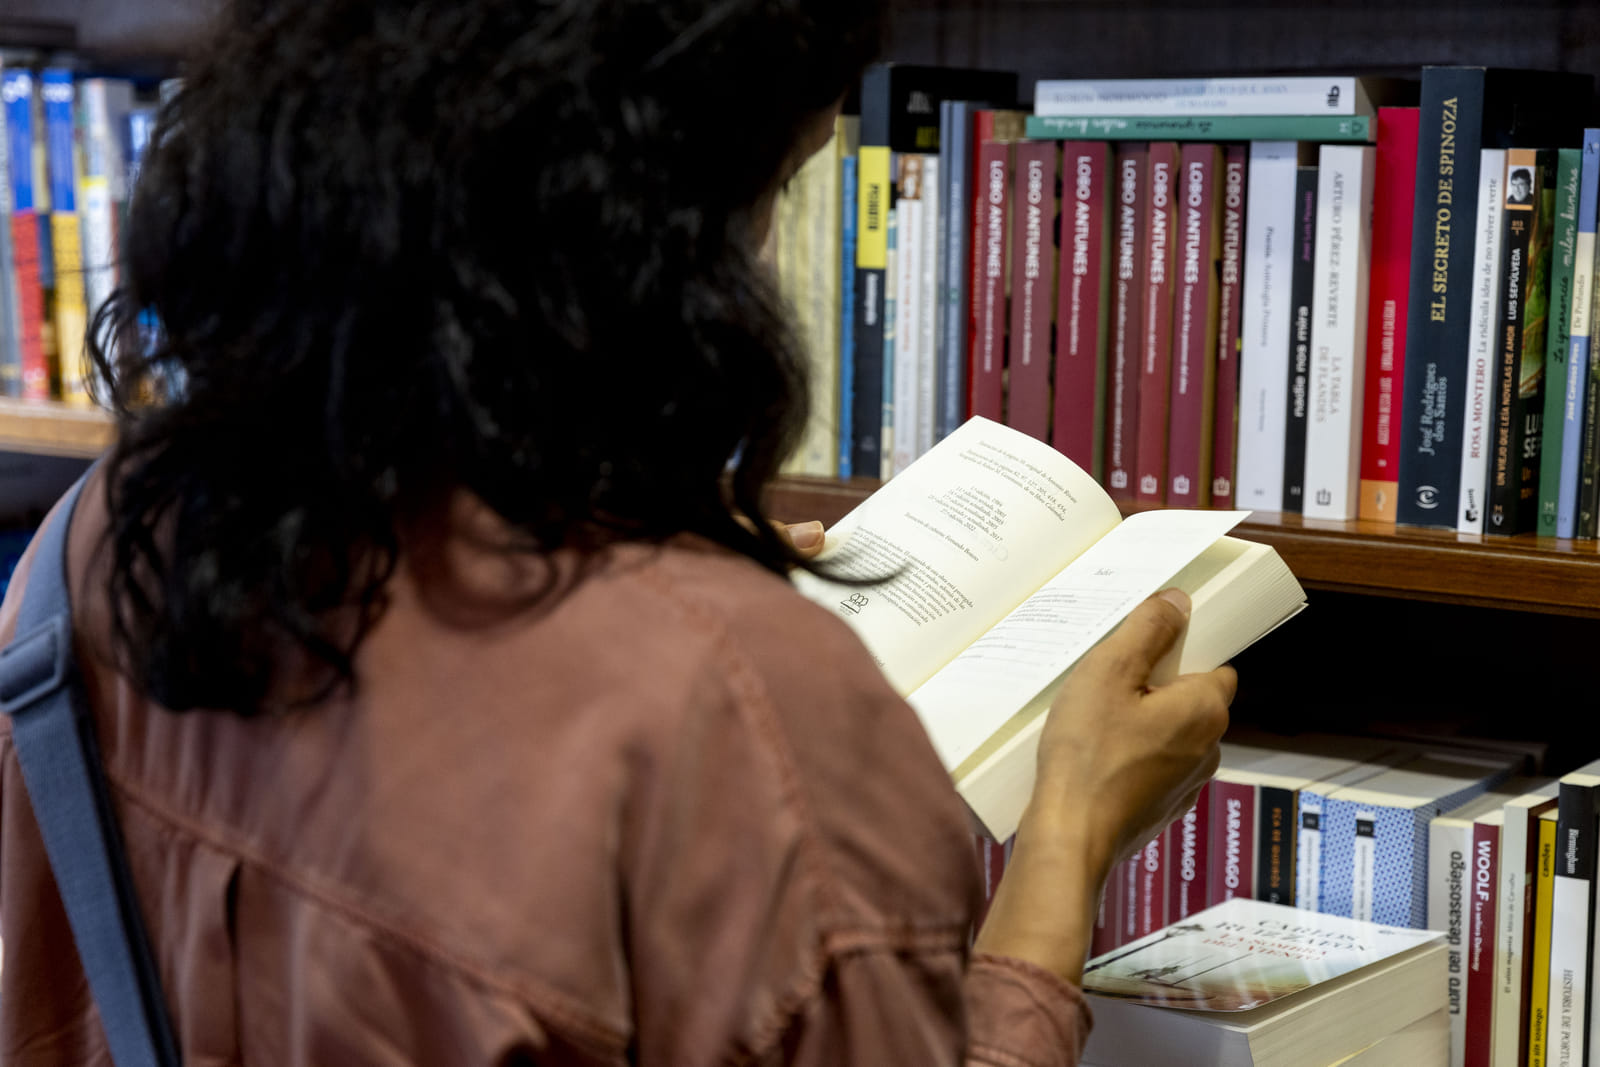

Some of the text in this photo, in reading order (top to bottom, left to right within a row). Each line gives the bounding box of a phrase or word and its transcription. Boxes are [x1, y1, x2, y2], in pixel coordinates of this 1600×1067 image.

[989, 160, 1003, 204] LOBO
[1077, 156, 1092, 200] LOBO
[1153, 162, 1168, 208] LOBO
[1188, 162, 1203, 208] LOBO
[1226, 163, 1241, 208] LOBO
[1331, 171, 1345, 223] ARTURO
[1487, 178, 1498, 202] verte
[1025, 160, 1042, 278] LOBO ANTUNES
[1119, 160, 1136, 280] LOBO ANTUNES
[1431, 97, 1458, 322] EL SECRETO DE SPINOZA
[1484, 214, 1496, 244] volver
[987, 205, 1002, 278] ANTUNES
[1073, 201, 1089, 275] ANTUNES
[1150, 208, 1166, 284] ANTUNES
[1184, 208, 1200, 284] ANTUNES
[1222, 208, 1238, 284] ANTUNES
[1485, 247, 1492, 261] no
[1480, 277, 1490, 297] idea
[1481, 263, 1491, 275] de
[1508, 247, 1521, 298] SEPÚLVEDA
[1477, 300, 1490, 338] ridícula
[1507, 301, 1518, 320] LUIS
[1476, 341, 1487, 353] La
[1504, 352, 1514, 364] DE
[1505, 325, 1516, 351] AMOR
[1292, 306, 1309, 417] nadie nos mira
[1567, 343, 1580, 421] José Cardoso Pires
[1473, 358, 1486, 423] MONTERO
[1503, 365, 1514, 405] NOVELAS
[1431, 376, 1447, 442] dos Santos
[1418, 427, 1435, 456] José
[1471, 427, 1481, 458] ROSA
[1499, 427, 1510, 446] QUE
[1497, 447, 1508, 472] VIEJO
[1497, 473, 1506, 486] UN
[1225, 799, 1241, 889] SARAMAGO
[1564, 829, 1580, 875] Birmingham
[1476, 841, 1491, 902] WOOLF
[1444, 851, 1467, 945] desasosiego
[1561, 969, 1575, 1014] HISTORIA
[1561, 1015, 1571, 1028] DE
